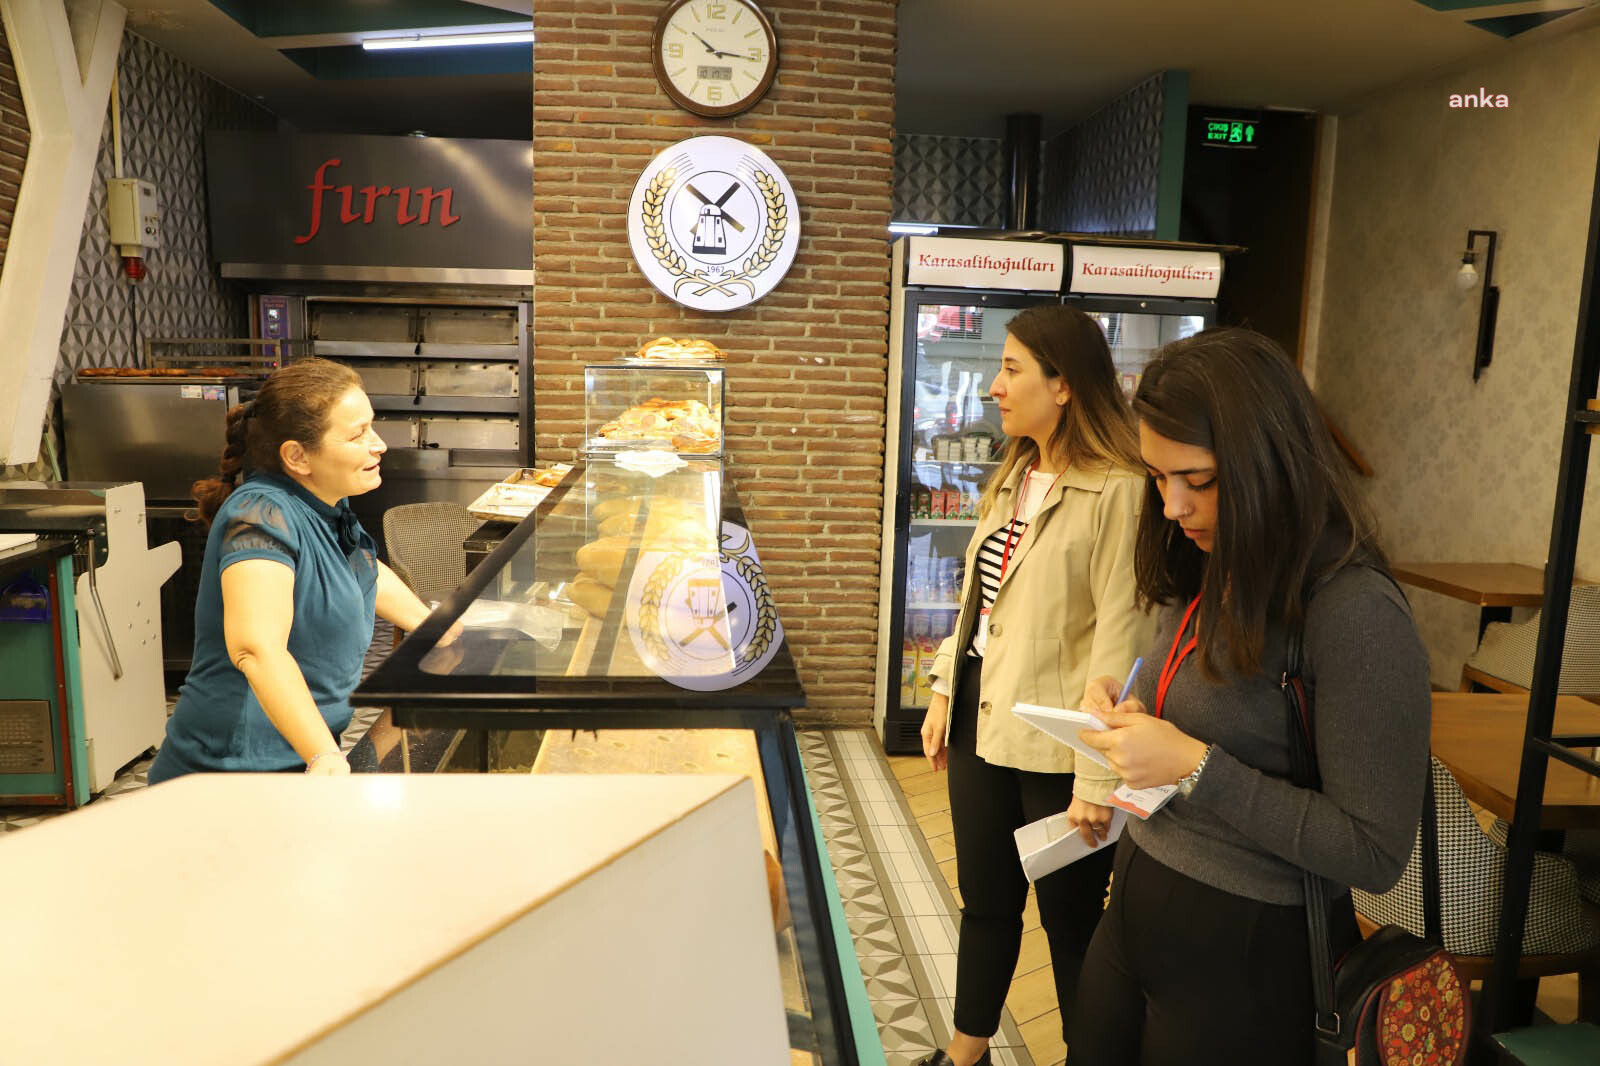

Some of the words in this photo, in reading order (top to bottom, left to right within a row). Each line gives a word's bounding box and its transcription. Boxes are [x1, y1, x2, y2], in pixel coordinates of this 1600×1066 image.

[707, 4, 727, 20] 12
[668, 43, 684, 58] 9
[748, 48, 761, 62] 3
[707, 86, 722, 101] 6
[1207, 132, 1228, 140] EXIT
[294, 159, 461, 245] fırın
[707, 265, 725, 273] 1967
